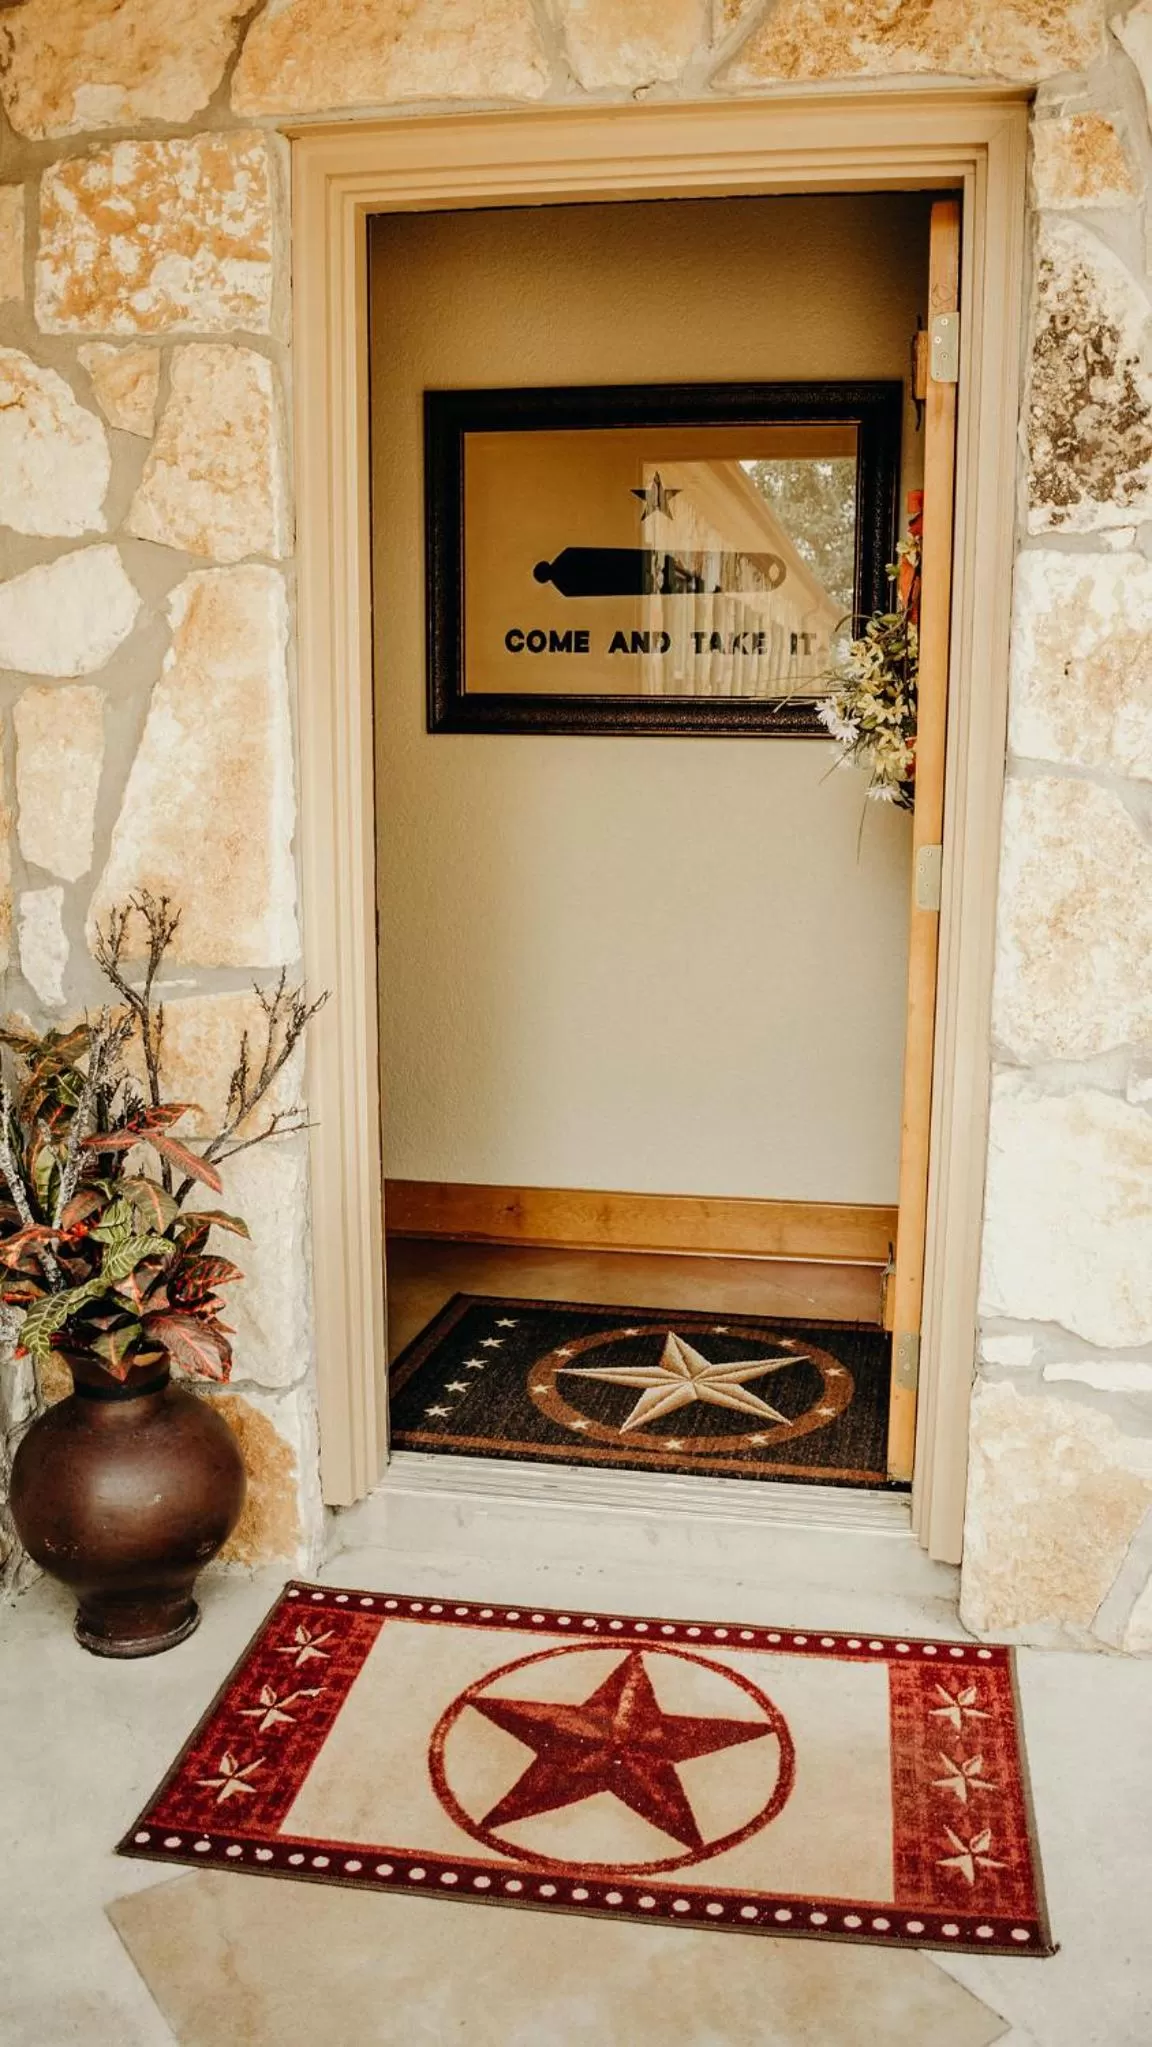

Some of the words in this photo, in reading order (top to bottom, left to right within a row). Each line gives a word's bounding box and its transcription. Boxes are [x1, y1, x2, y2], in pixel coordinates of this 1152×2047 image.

[504, 629, 591, 654] COME
[608, 630, 671, 655] AND
[691, 631, 767, 656] TAKE
[789, 631, 817, 656] IT
